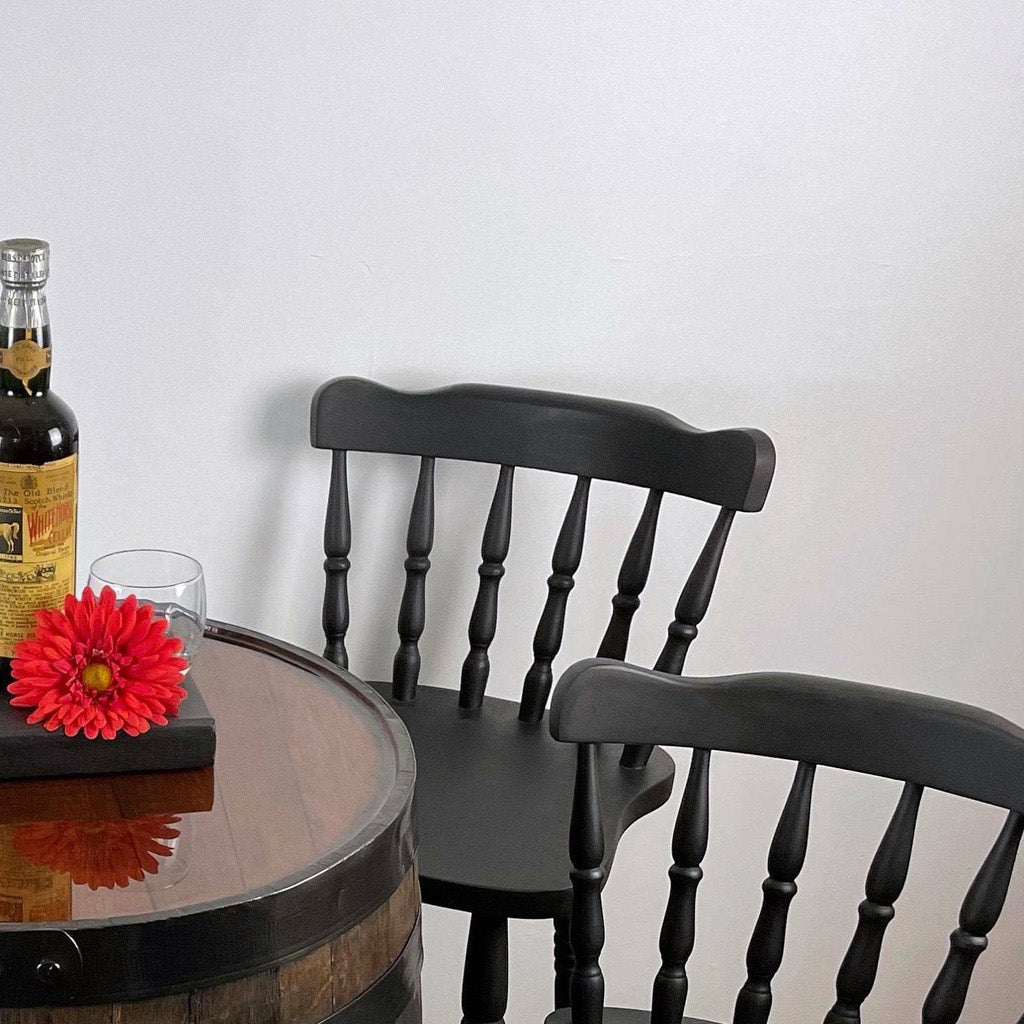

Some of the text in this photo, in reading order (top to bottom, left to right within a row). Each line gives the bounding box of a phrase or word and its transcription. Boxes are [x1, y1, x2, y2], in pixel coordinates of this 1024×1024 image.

[3, 484, 70, 497] The Old Blend
[24, 497, 52, 506] Scotch
